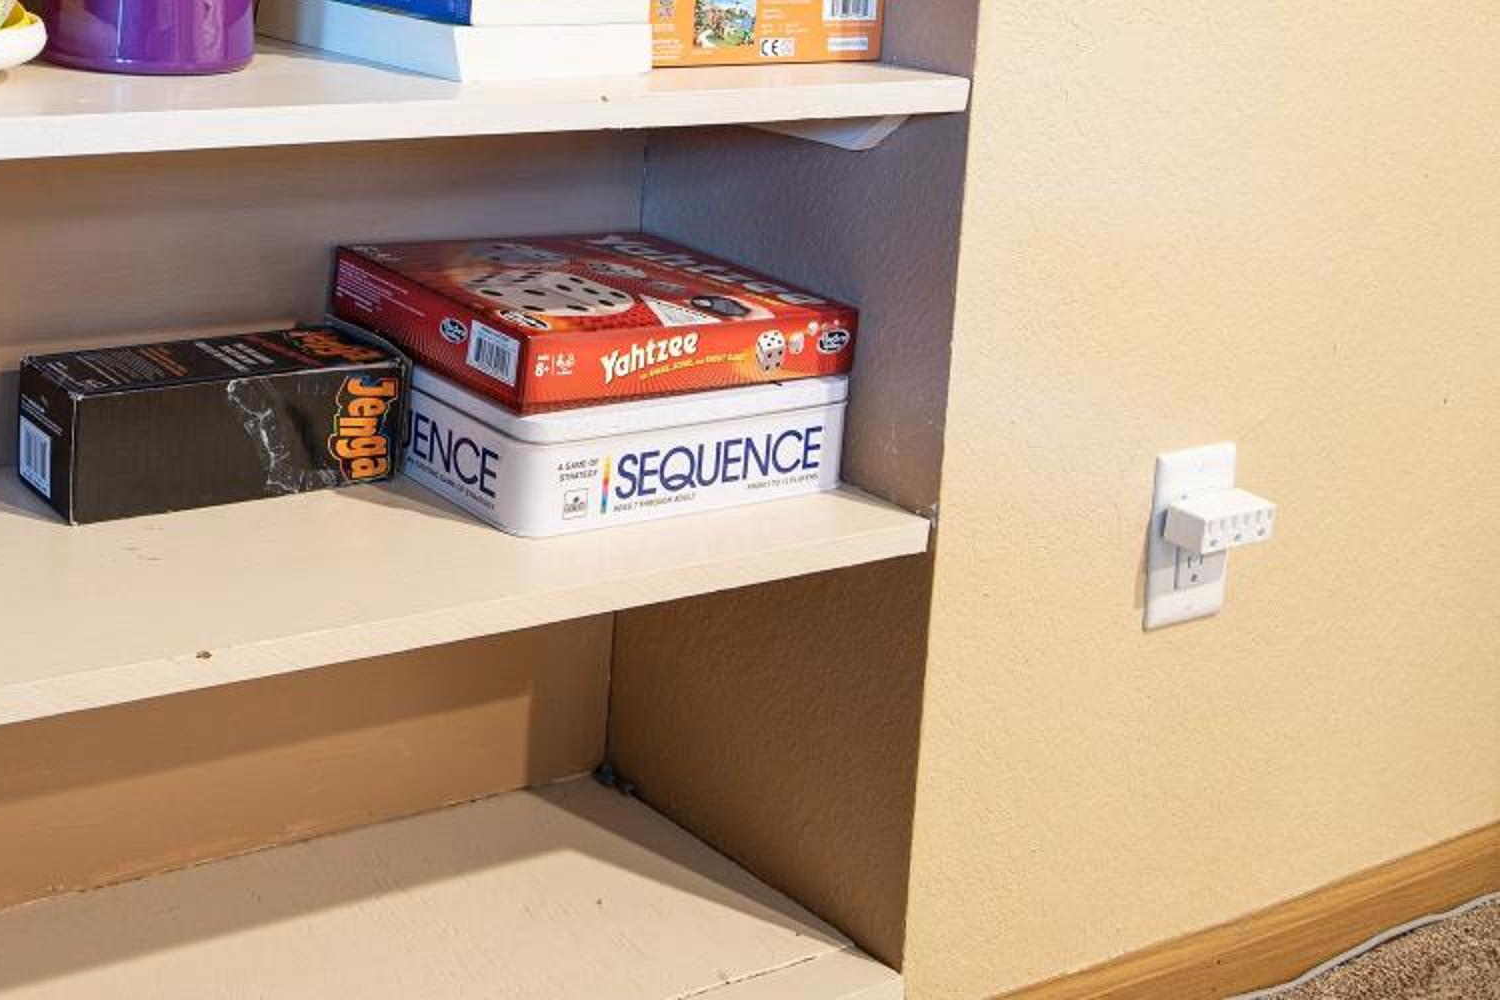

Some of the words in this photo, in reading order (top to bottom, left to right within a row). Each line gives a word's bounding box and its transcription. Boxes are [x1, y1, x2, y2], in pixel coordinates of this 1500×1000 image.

[600, 332, 700, 385] Yahtzee
[335, 376, 400, 480] Jenga
[614, 425, 823, 500] SEQUENCE
